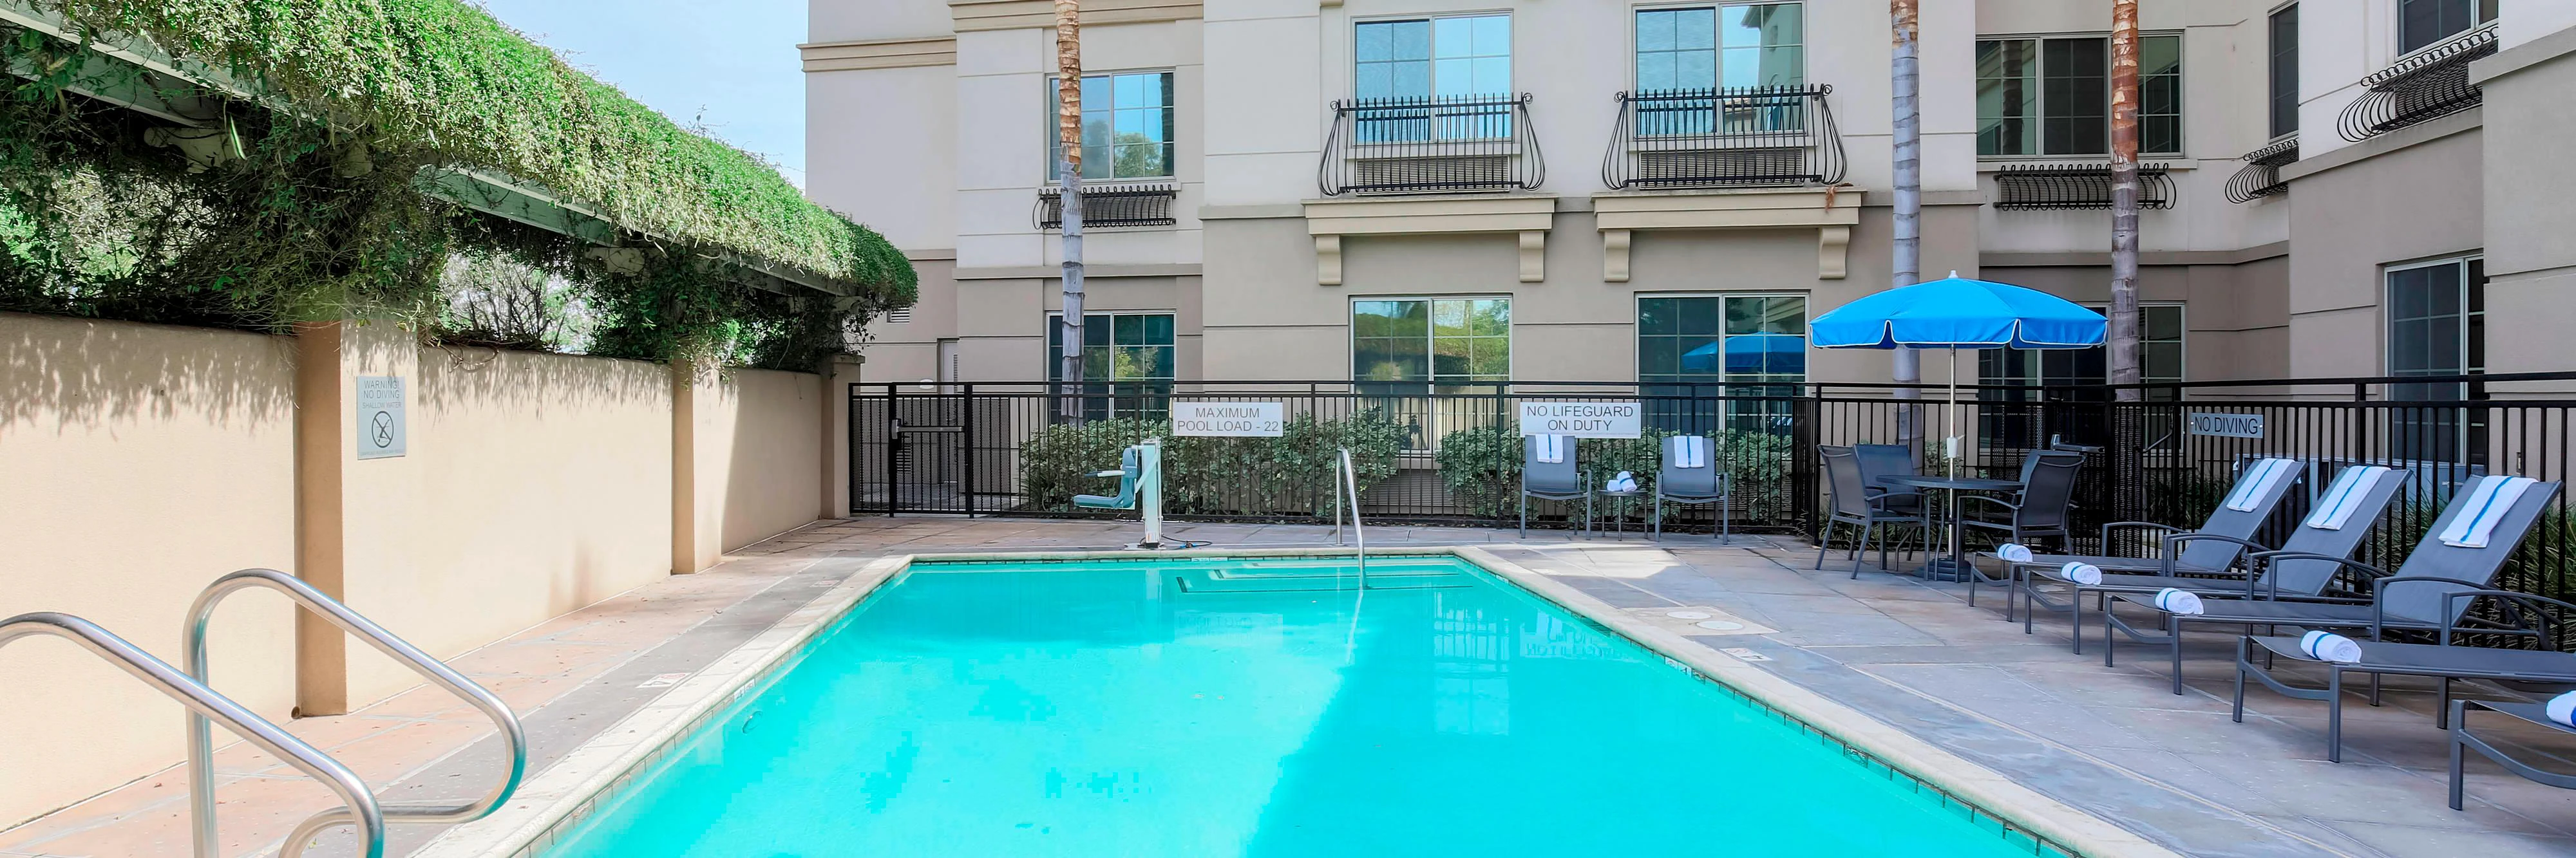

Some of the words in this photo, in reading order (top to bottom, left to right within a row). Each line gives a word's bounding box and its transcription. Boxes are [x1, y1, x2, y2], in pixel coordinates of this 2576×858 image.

[364, 380, 399, 389] WARNING!
[363, 390, 374, 399] NO
[377, 390, 400, 398] DIVING
[1195, 407, 1260, 418] MAXIMUM
[1527, 406, 1548, 416] NO
[1553, 406, 1633, 417] LIFEGUARD
[1178, 420, 1212, 431] POOL
[1217, 420, 1252, 431] LOAD
[1264, 420, 1279, 432] 22
[1548, 420, 1567, 431] ON
[1574, 420, 1612, 431] DUTY
[2195, 416, 2211, 432] NO
[2214, 416, 2258, 434] DIVING
